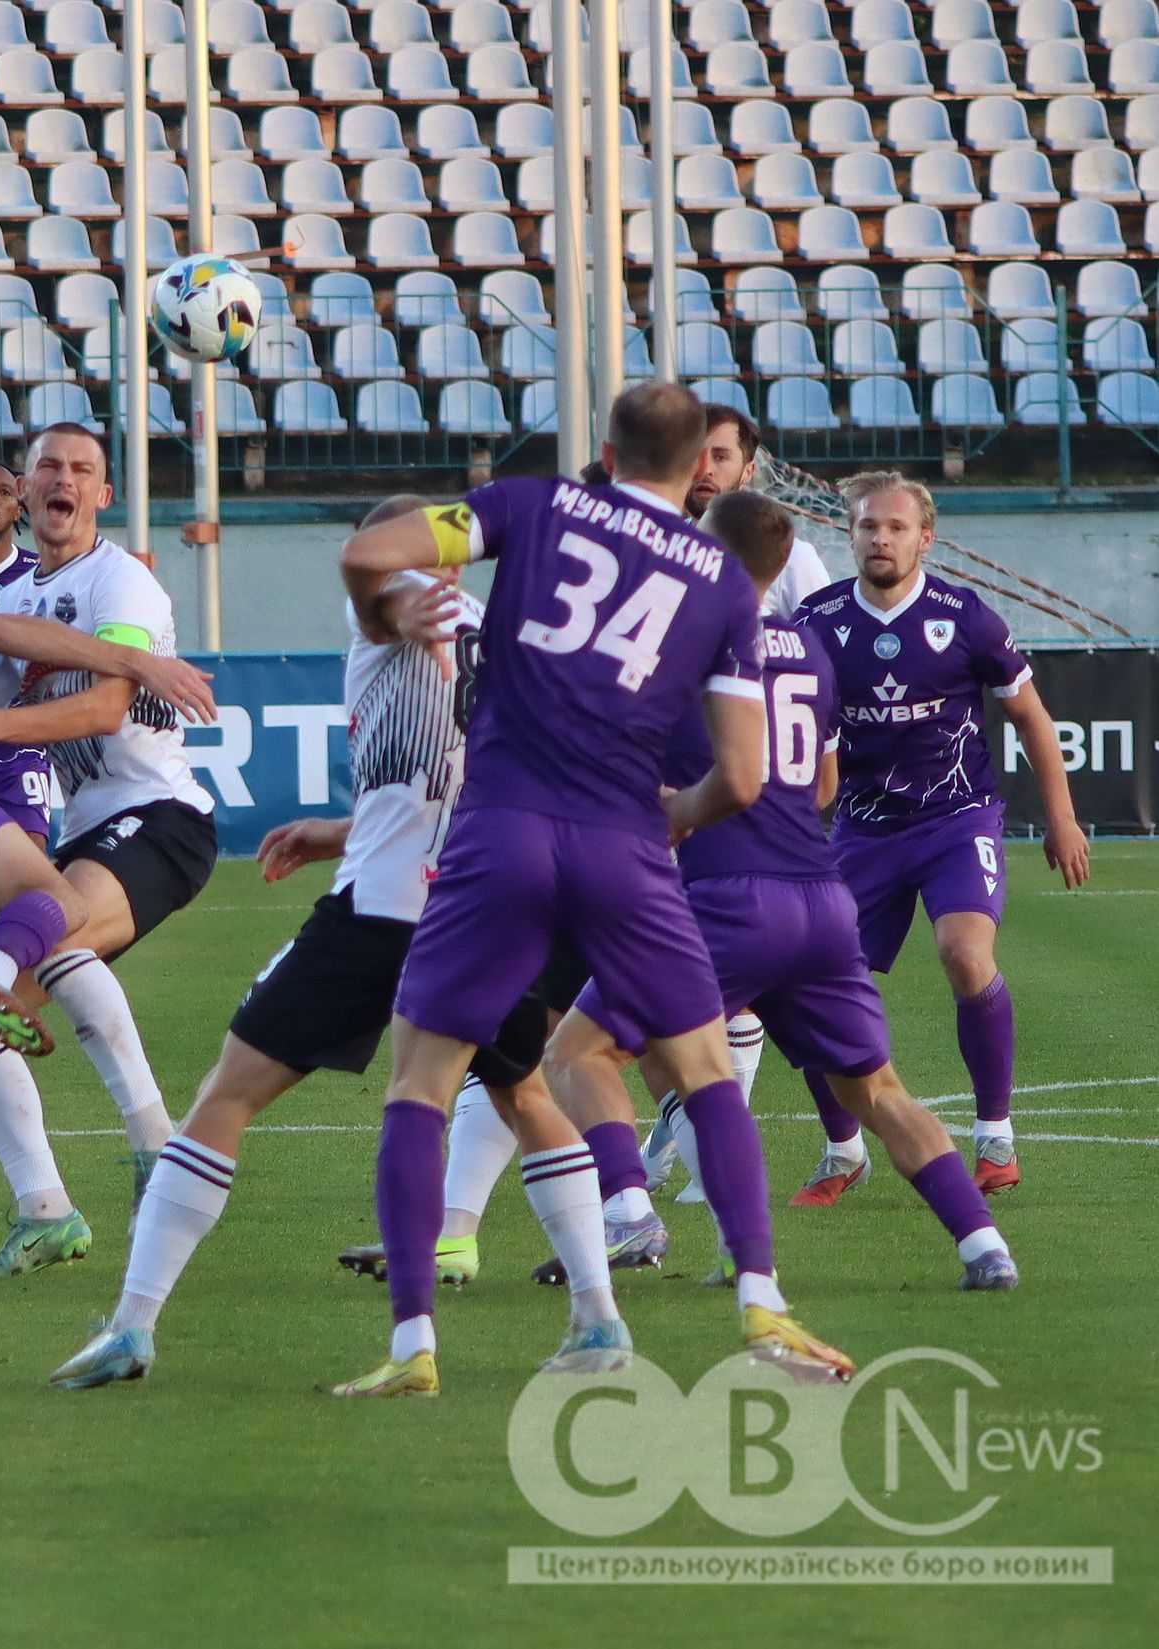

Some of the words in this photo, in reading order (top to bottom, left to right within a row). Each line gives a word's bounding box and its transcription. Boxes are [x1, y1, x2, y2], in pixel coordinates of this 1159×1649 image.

[551, 482, 724, 584] МУРАВСЬКИЙ
[517, 530, 688, 693] 34
[761, 628, 806, 660] БОВ
[844, 697, 946, 723] FAVBET
[974, 836, 998, 875] 6
